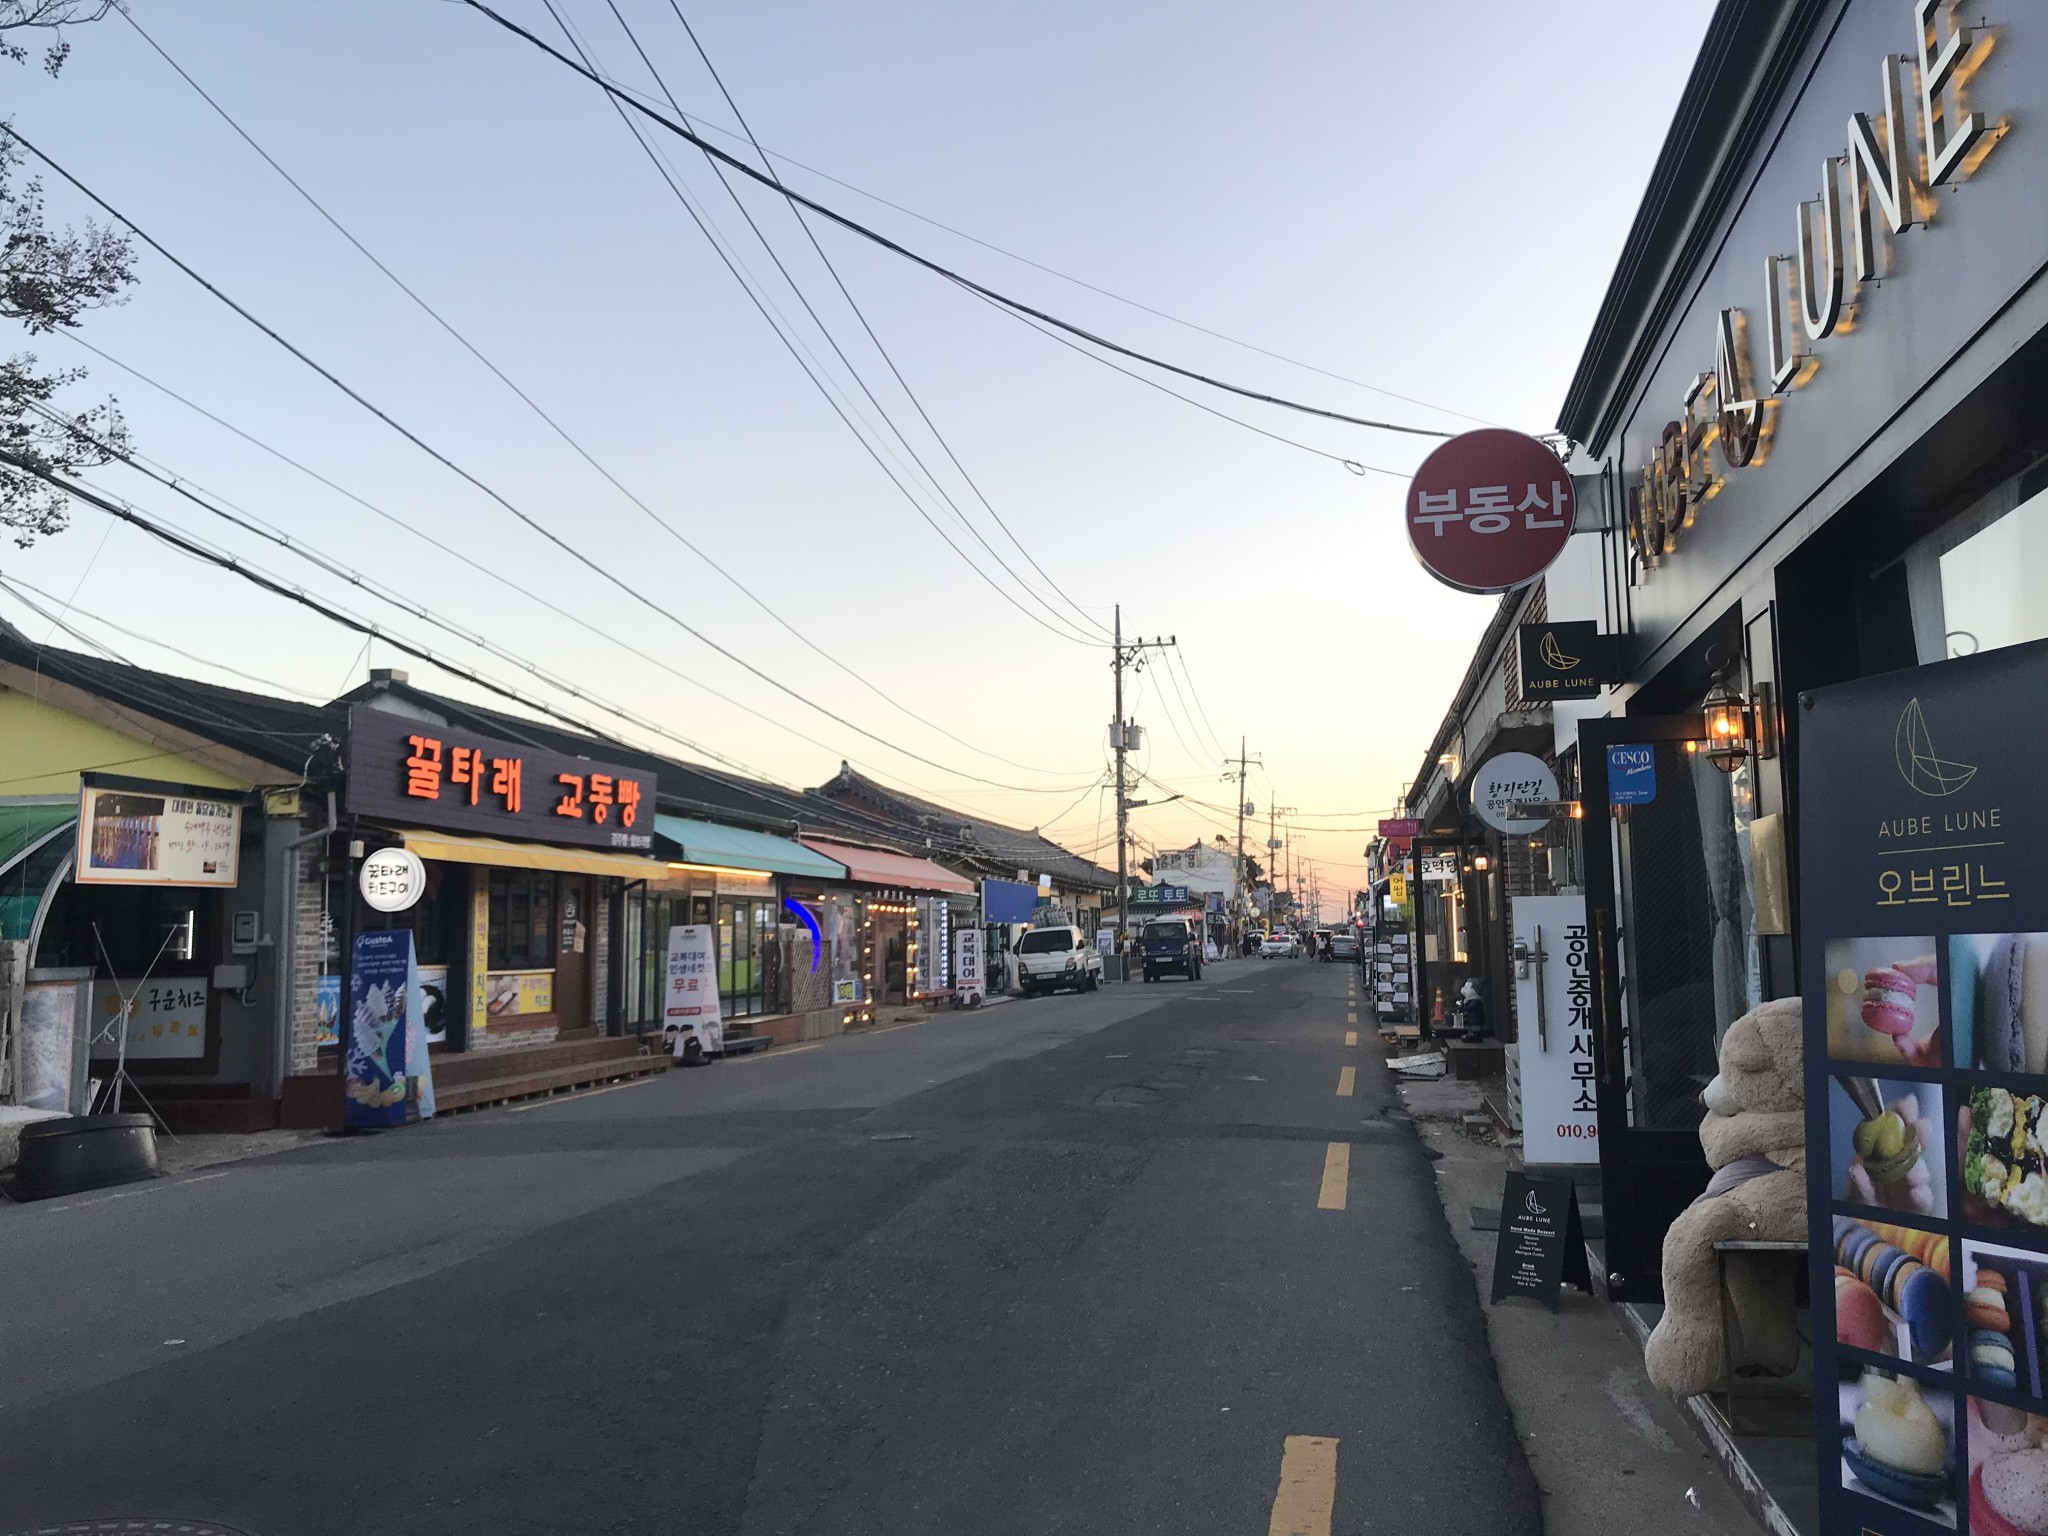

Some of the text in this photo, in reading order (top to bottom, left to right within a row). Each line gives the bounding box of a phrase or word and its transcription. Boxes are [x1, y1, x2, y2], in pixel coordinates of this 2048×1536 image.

[1765, 0, 1986, 395] LUNE
[1413, 480, 1568, 537] 부동산
[1529, 677, 1595, 690] AUBE LUNE
[1612, 750, 1650, 765] CESCO
[406, 734, 641, 828] 꿀타래 교동빵
[1488, 778, 1545, 799] 황리단길
[1878, 808, 2001, 839] AUBE LUNE
[368, 864, 408, 878] 꿀타래
[368, 881, 408, 895] 치즈구이
[1393, 877, 1403, 897] 어썸
[1876, 862, 2010, 907] 오브린느
[1138, 888, 1188, 903] 로또 토토
[962, 932, 975, 978] 교복대여
[672, 978, 699, 993] 무료
[149, 987, 205, 1012] 구운치즈
[1563, 924, 1598, 1112] 공인중개사무소
[1556, 1124, 1600, 1139] 010.9
[1517, 1214, 1551, 1224] AUBE LUNE
